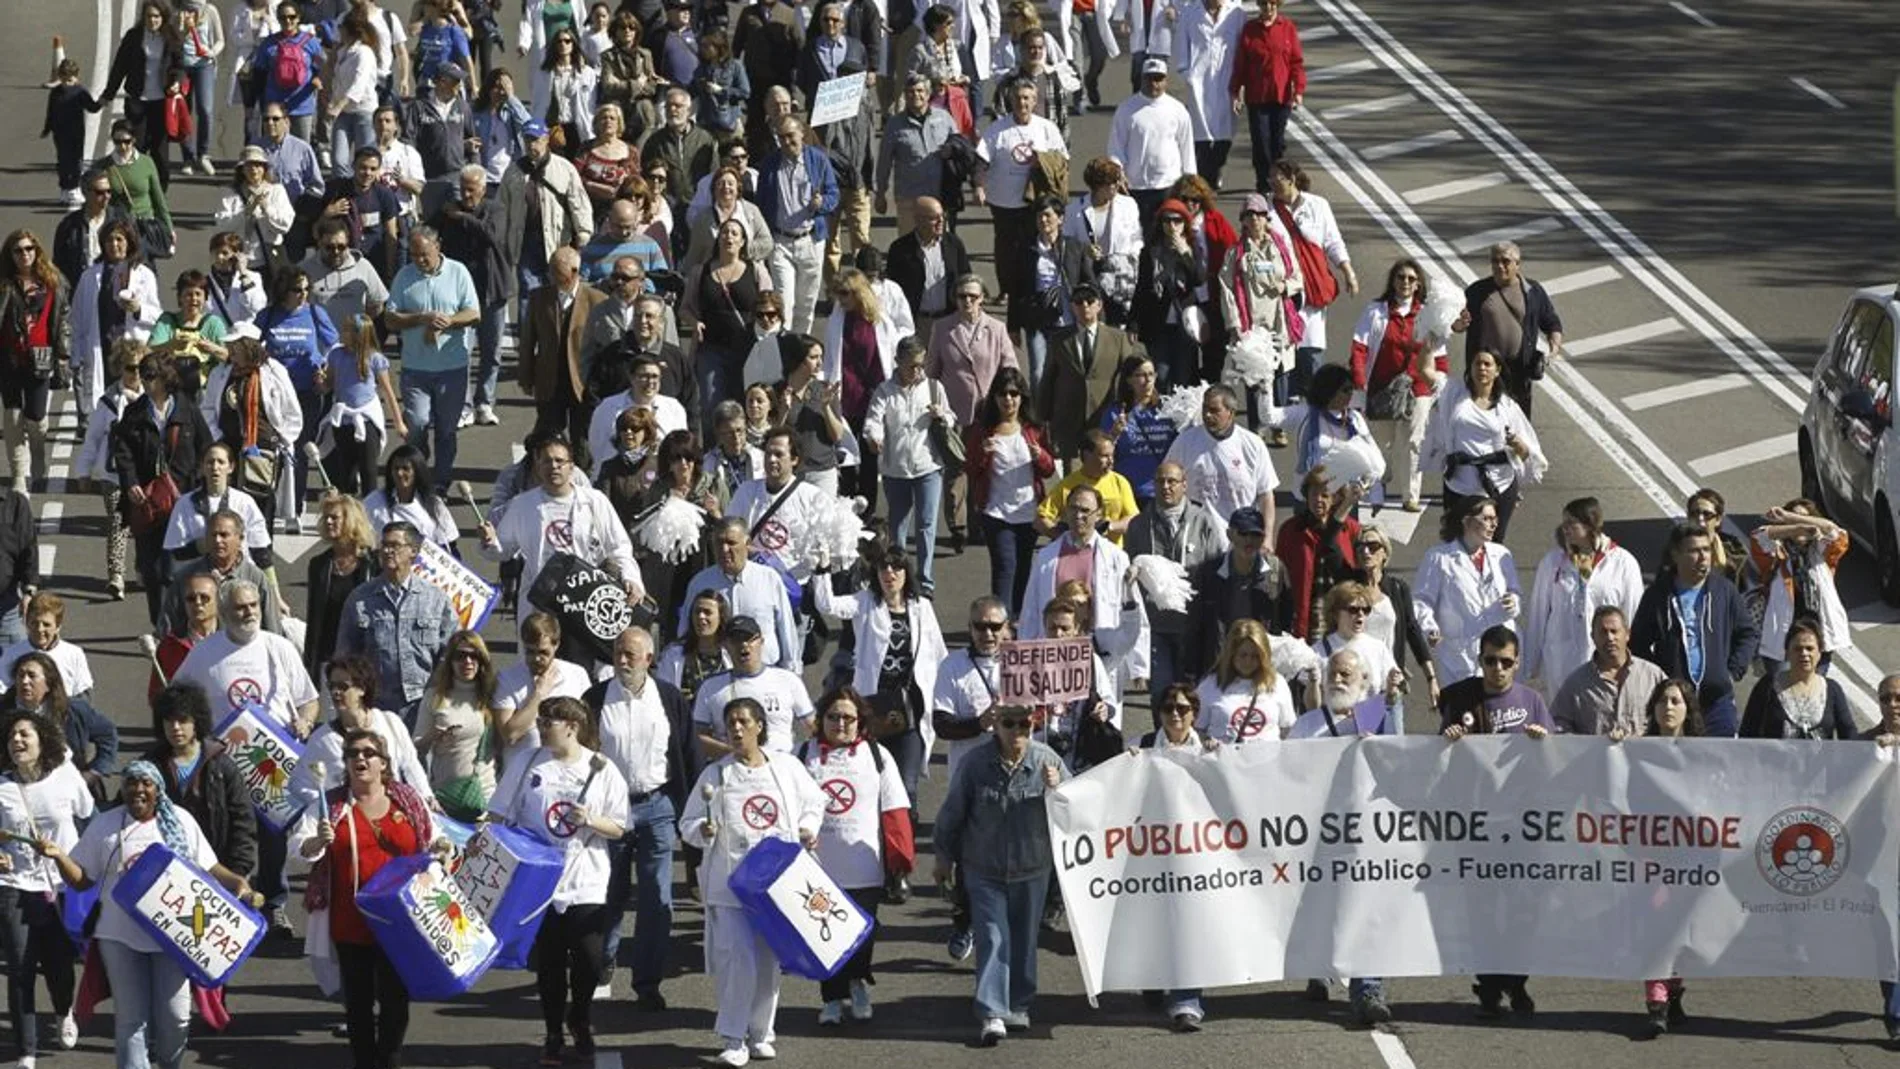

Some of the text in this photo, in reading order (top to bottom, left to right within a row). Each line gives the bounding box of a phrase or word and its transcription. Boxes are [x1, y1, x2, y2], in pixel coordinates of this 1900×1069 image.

[599, 600, 620, 621] SP
[1002, 667, 1090, 697] TU SALUD!
[252, 727, 296, 775] TOD@
[1062, 834, 1094, 870] LO
[1105, 816, 1248, 859] PÚBLICO
[1260, 814, 1308, 848] NO
[1320, 812, 1363, 844] SE
[1374, 810, 1489, 843] VENDE
[1521, 810, 1565, 842] SE
[1576, 812, 1741, 849] DEFIENDE
[1089, 868, 1263, 899] Coordinadora
[1272, 862, 1290, 884] X
[1299, 861, 1323, 883] lo
[1332, 858, 1432, 882] Público
[1459, 857, 1601, 882] Fuencarral
[1611, 860, 1635, 883] El
[1644, 861, 1721, 886] Pardo
[160, 883, 242, 962] LA PAZ
[190, 879, 241, 929] COCINA
[151, 911, 211, 969] EN LUCHA
